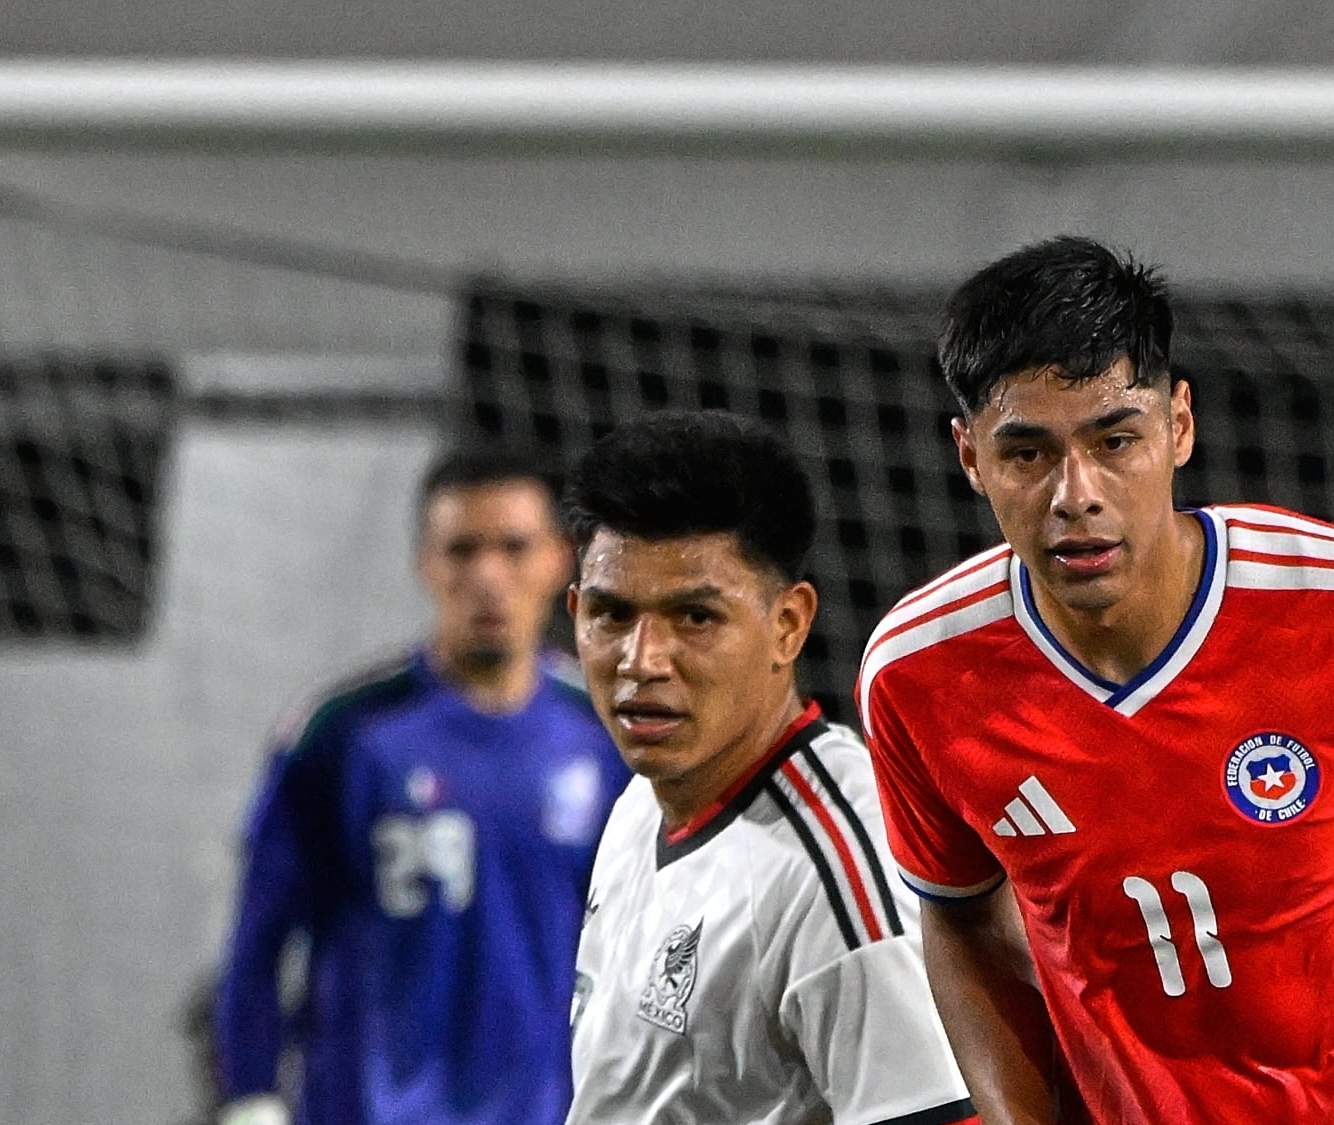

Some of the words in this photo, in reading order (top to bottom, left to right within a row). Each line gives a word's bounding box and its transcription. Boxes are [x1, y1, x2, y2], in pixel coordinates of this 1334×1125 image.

[1269, 734, 1283, 746] DE
[1258, 809, 1273, 822] DE
[1277, 798, 1307, 820] CHILE
[1122, 870, 1233, 997] 11
